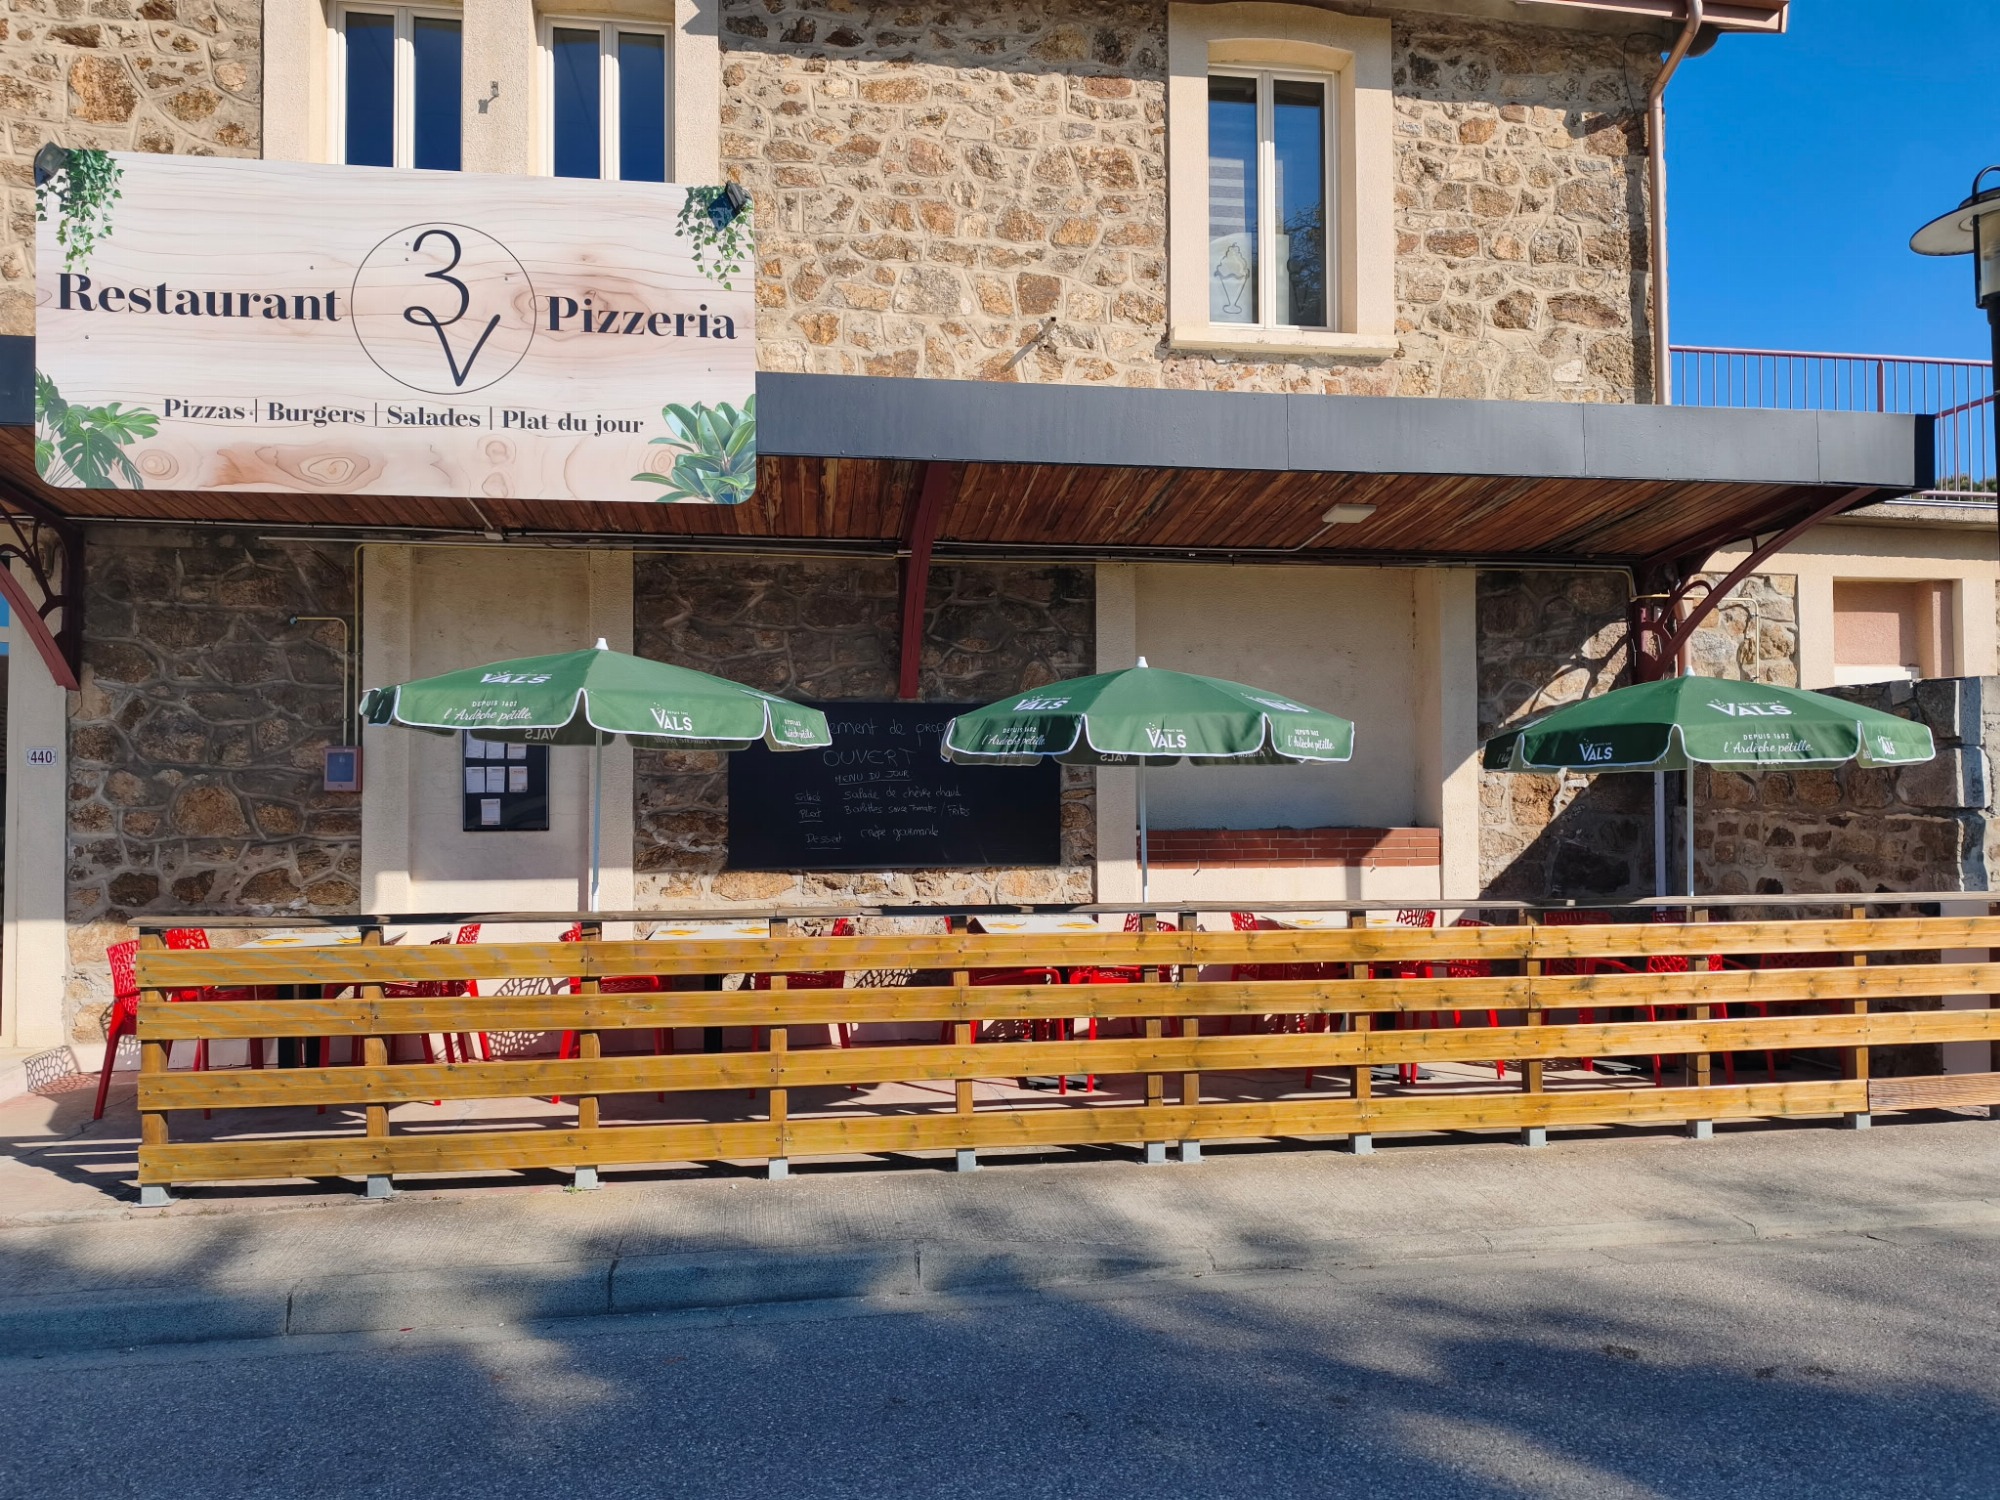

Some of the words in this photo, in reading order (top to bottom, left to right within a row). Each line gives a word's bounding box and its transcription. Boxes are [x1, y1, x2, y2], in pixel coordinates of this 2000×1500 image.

[55, 272, 343, 322] Restaurant
[545, 295, 739, 340] Pizzeria
[163, 398, 246, 420] Pizzas
[267, 402, 366, 428] Burgers
[387, 405, 481, 427] Salades
[502, 410, 550, 430] Plat
[558, 412, 588, 432] du
[594, 414, 644, 437] jour
[480, 673, 552, 684] VALS
[1013, 699, 1069, 711] VALS
[1706, 702, 1793, 717] VALS
[650, 708, 694, 732] VALS
[889, 718, 906, 735] de
[1145, 728, 1187, 748] VALS
[30, 750, 53, 763] 440
[823, 747, 917, 767] OUVERT
[1579, 743, 1613, 762] VALS
[834, 773, 864, 784] MENU
